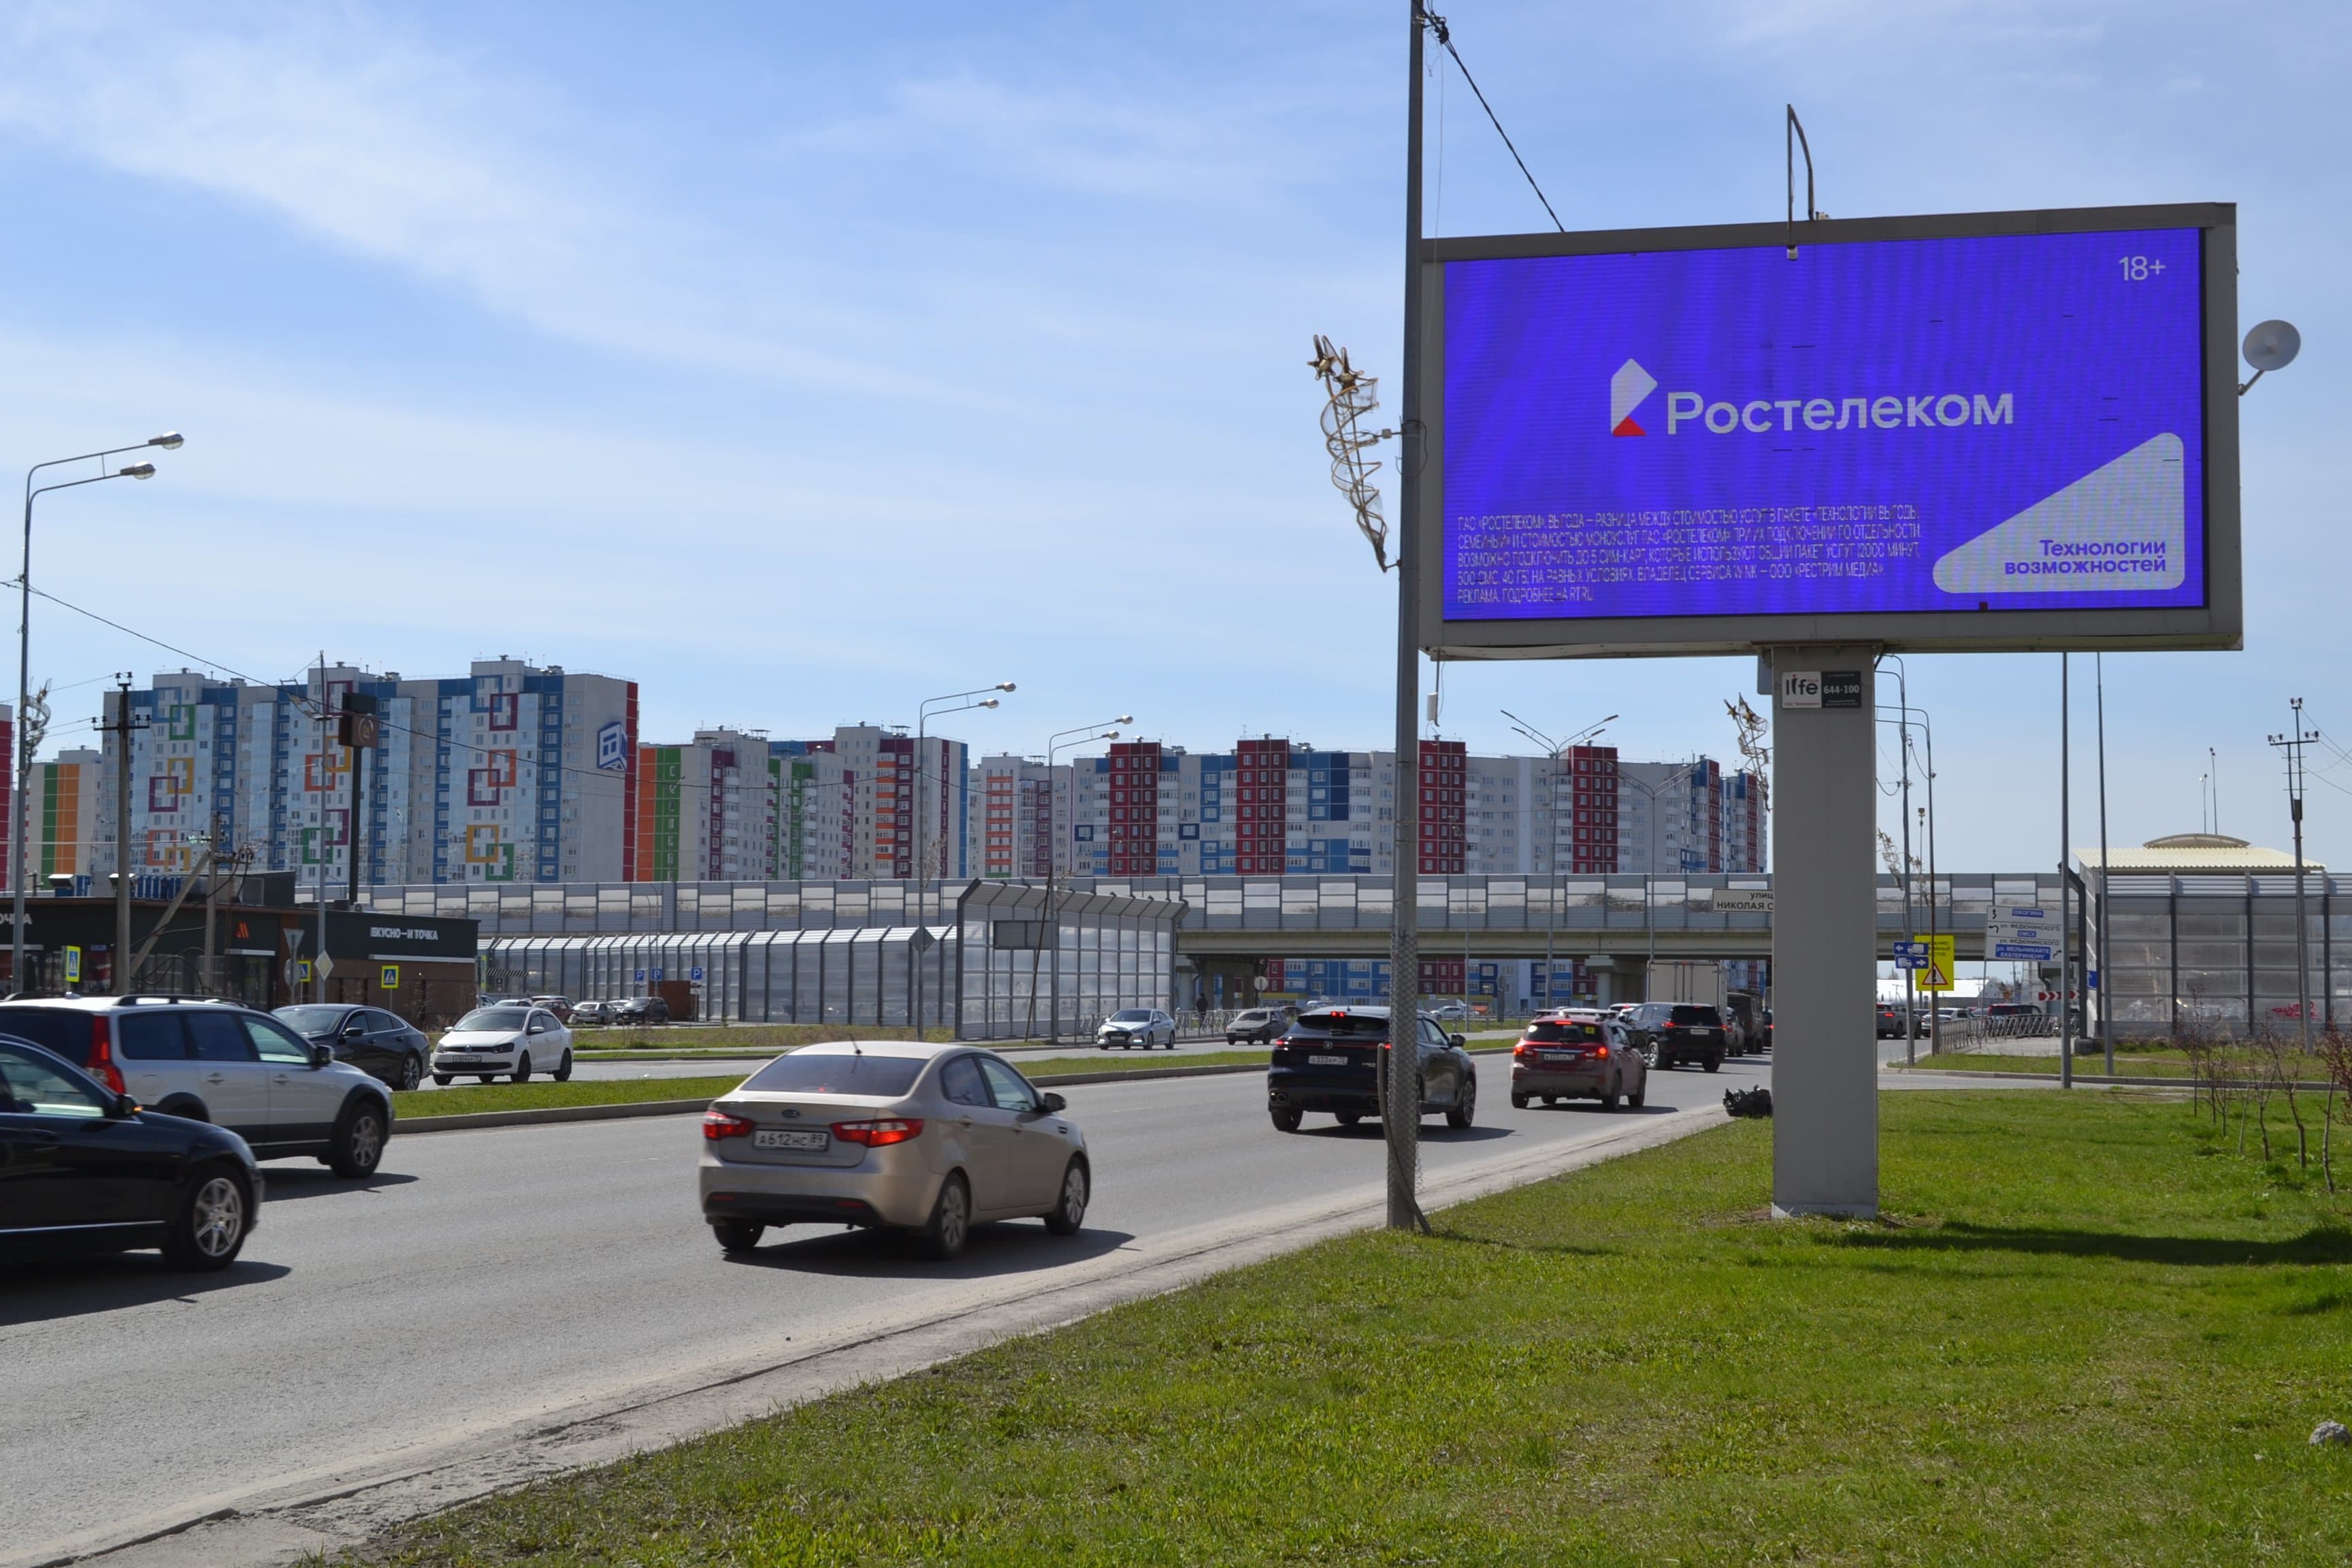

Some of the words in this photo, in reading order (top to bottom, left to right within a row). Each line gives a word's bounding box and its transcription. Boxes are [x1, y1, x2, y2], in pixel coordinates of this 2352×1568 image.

[2119, 256, 2166, 280] 18+
[1667, 391, 2013, 436] Ростелеком
[2040, 540, 2166, 557] Технологии
[2004, 555, 2166, 574] возможностей
[1786, 674, 1818, 695] life
[1824, 685, 1860, 694] 644-100
[1717, 902, 1765, 910] НИКОЛАЯ
[414, 929, 439, 941] ТОЧКА
[2010, 924, 2060, 932] ФЕДЮНИНСКОГО
